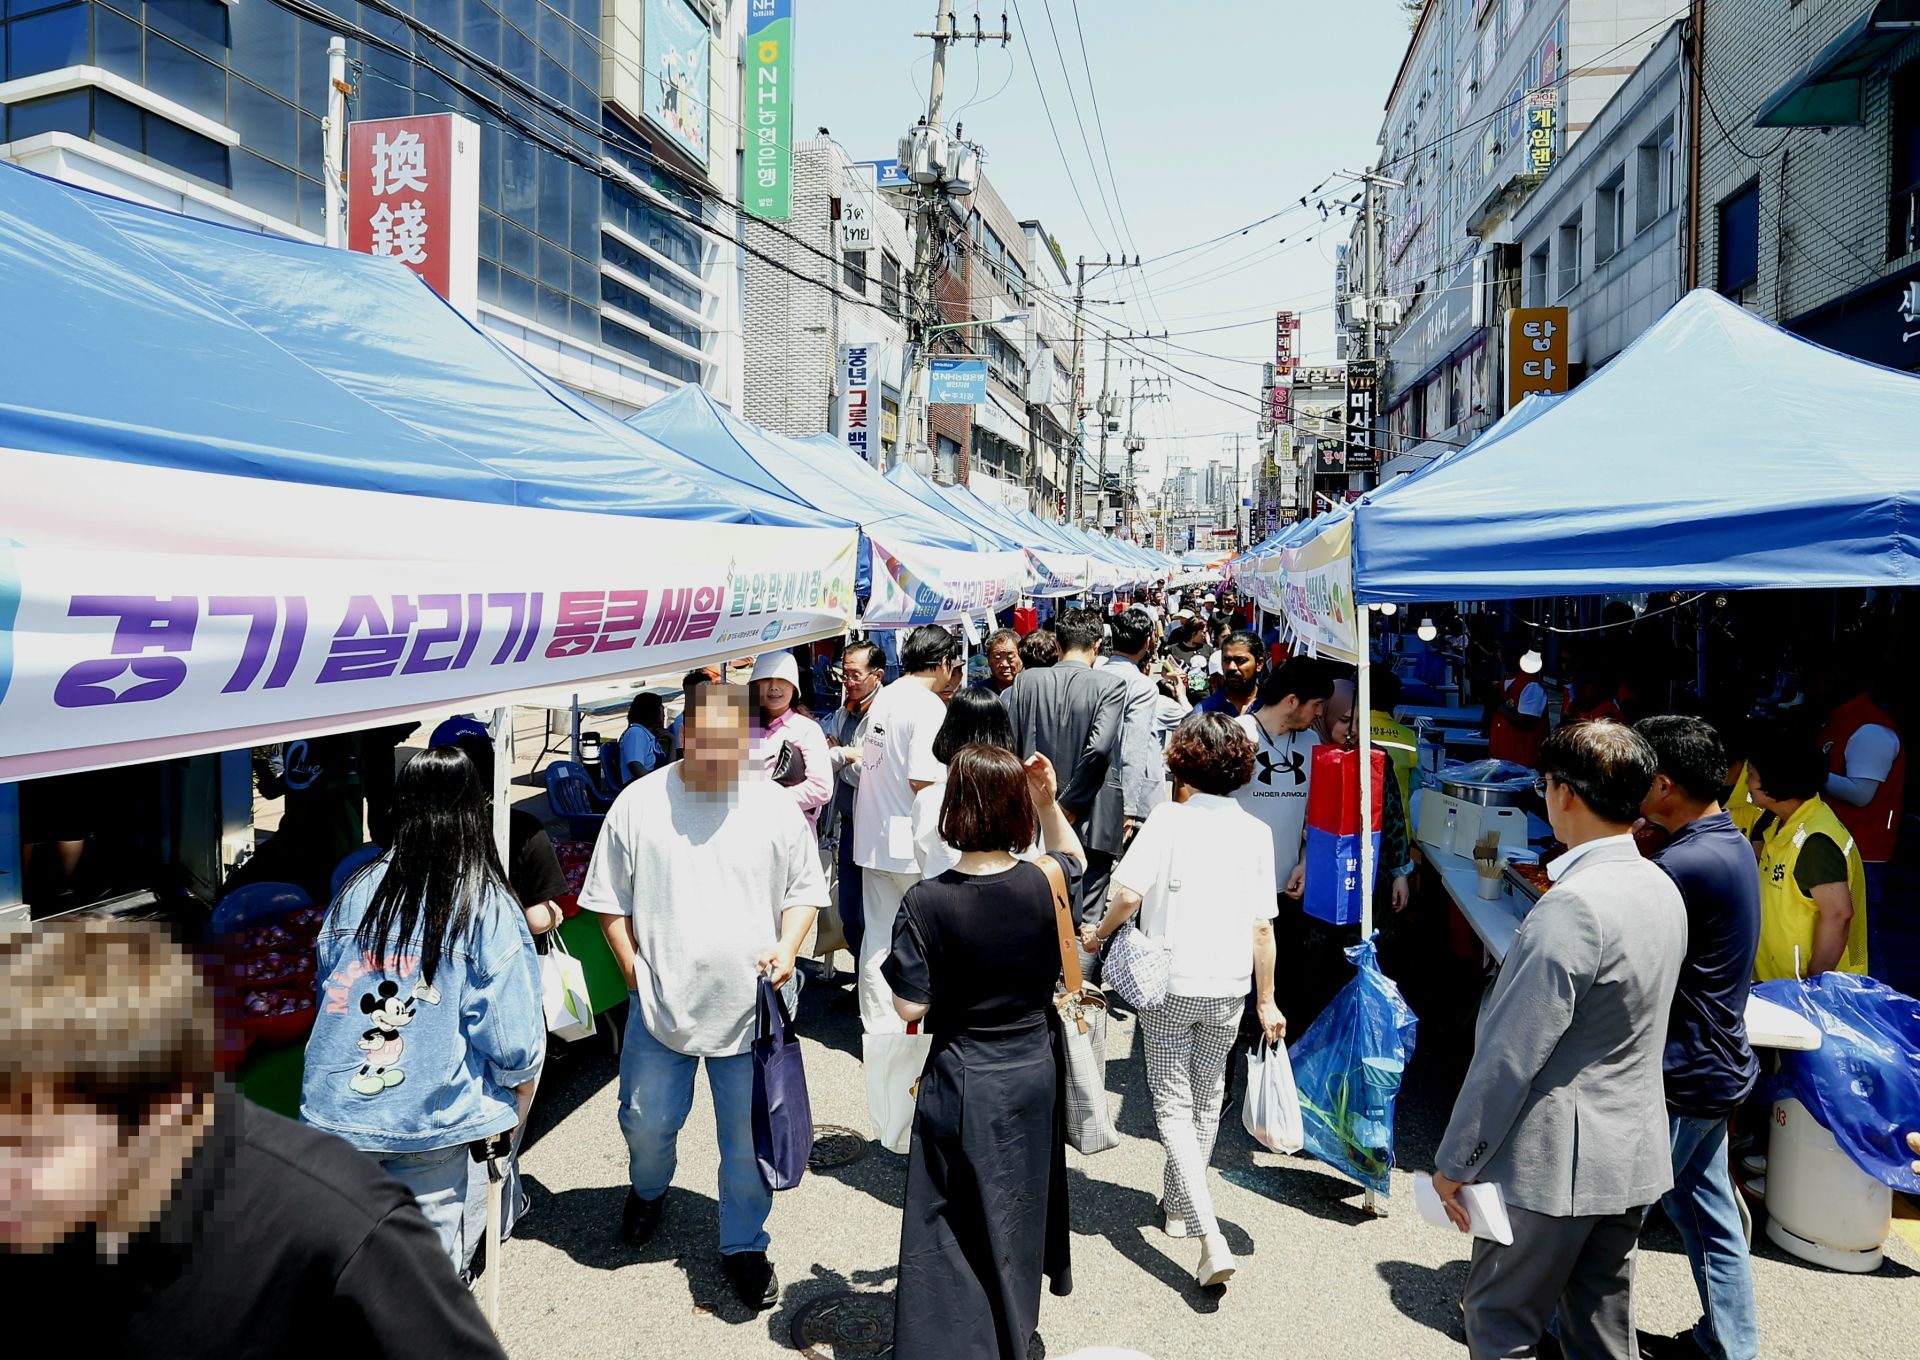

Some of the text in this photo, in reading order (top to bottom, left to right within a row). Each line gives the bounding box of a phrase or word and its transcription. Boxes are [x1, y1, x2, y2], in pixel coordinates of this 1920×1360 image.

[758, 66, 777, 188] NH농협은행
[369, 129, 429, 281] 換錢
[842, 226, 869, 241] ไทย
[1349, 377, 1376, 390] VIP
[1350, 391, 1373, 451] 마사지
[848, 431, 868, 461] 백
[53, 594, 308, 708] 경기
[315, 591, 544, 684] 살리기
[544, 589, 647, 658] 통큰
[644, 585, 724, 648] 세일
[1345, 858, 1358, 891] 발안
[1775, 1106, 1787, 1127] 03
